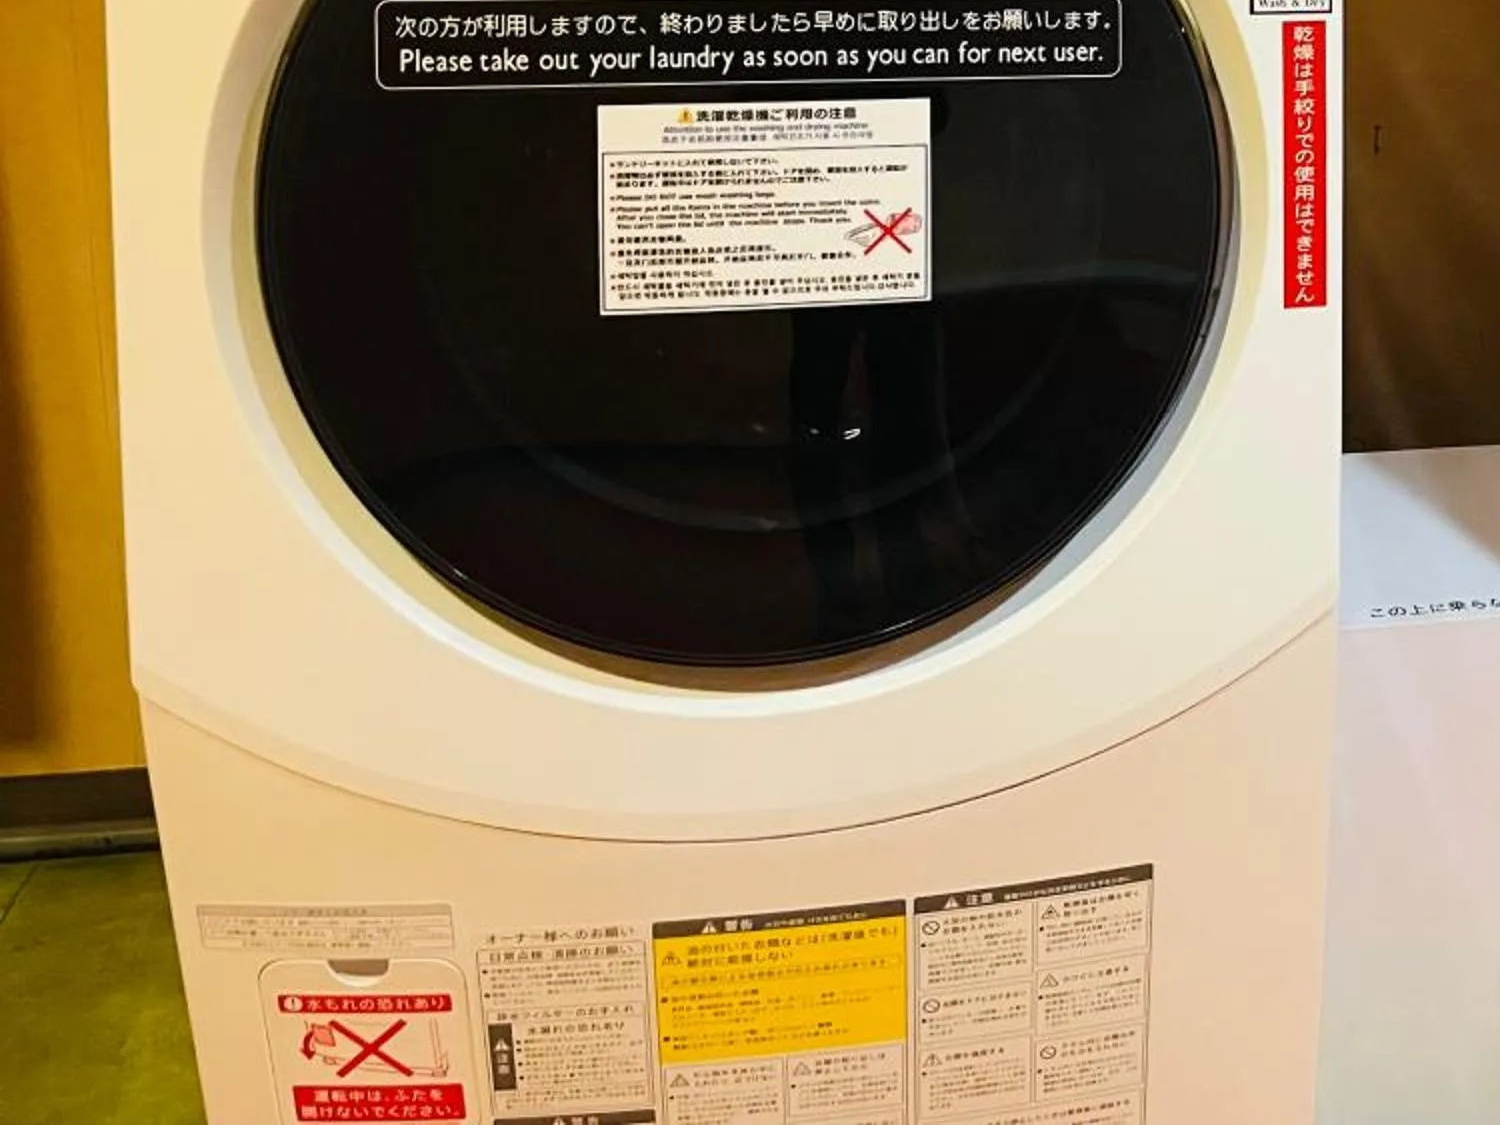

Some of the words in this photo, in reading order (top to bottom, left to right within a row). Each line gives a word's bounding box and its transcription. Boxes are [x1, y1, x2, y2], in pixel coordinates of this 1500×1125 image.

[394, 9, 1111, 39] 次の方が利用しますので、終わりましたら早めに取り出しをお願いします。
[400, 48, 473, 73] Please
[480, 48, 529, 73] take
[539, 51, 579, 71] out
[589, 52, 642, 77] your
[650, 45, 735, 76] laundry
[743, 49, 766, 66] as
[774, 49, 828, 67] soon
[837, 48, 859, 66] as
[867, 47, 907, 73] you
[913, 47, 949, 64] can
[958, 41, 991, 64] for
[998, 44, 1046, 63] next
[1053, 44, 1104, 63] user.
[696, 106, 857, 123] 洗濯乾燥機ご利用の注意
[1293, 26, 1315, 303] 乾燥は手絞りでの使用はできません
[305, 997, 447, 1012] 水もれの恐れあり
[302, 1102, 462, 1119] 開けないでください。
